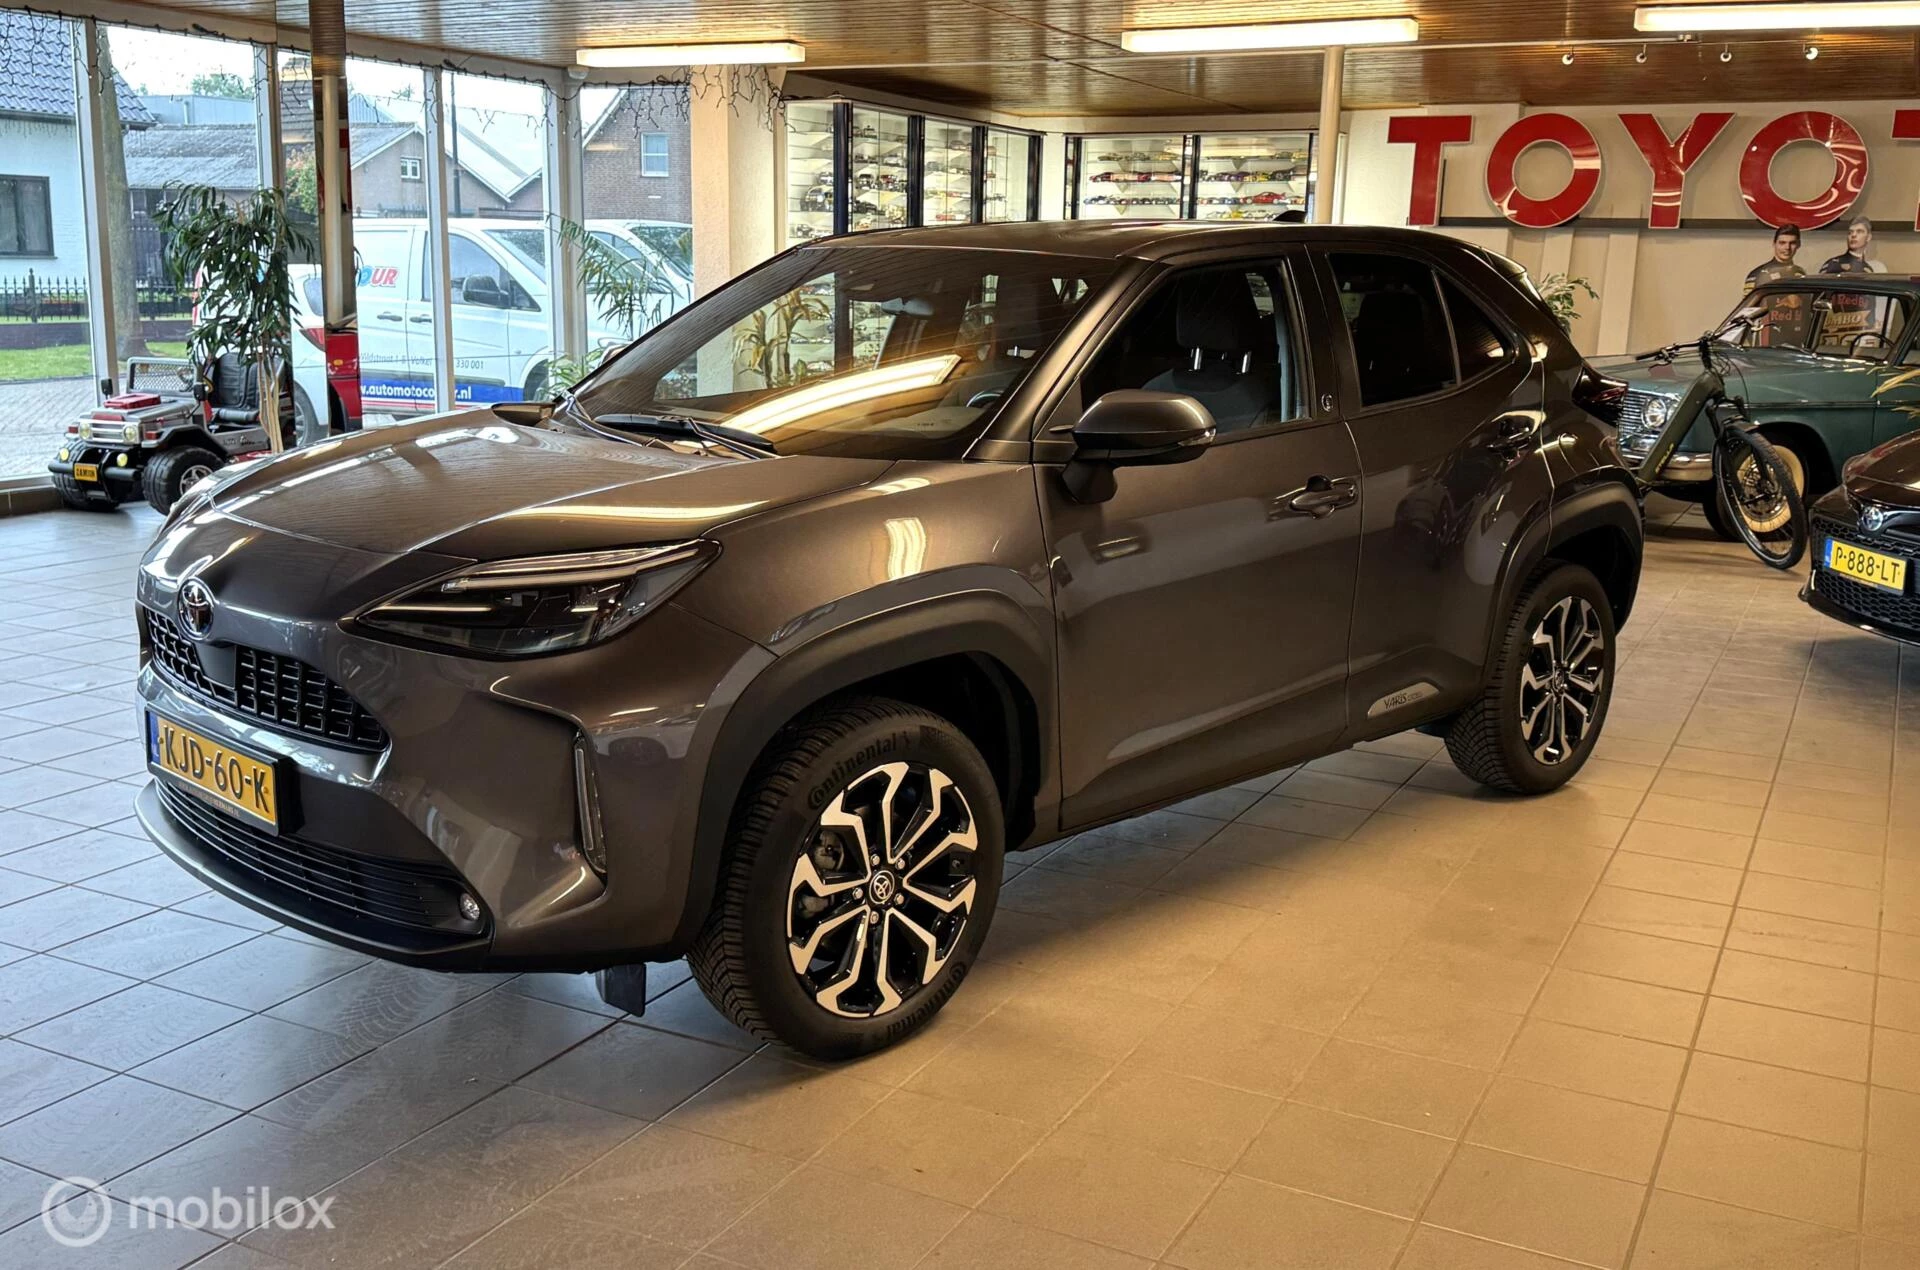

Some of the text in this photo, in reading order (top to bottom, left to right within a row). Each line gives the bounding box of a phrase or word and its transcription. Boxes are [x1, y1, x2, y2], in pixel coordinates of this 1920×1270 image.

[1835, 546, 1900, 583] P-888-LT
[163, 724, 270, 814] KJD-60-K
[807, 731, 897, 810] Continental
